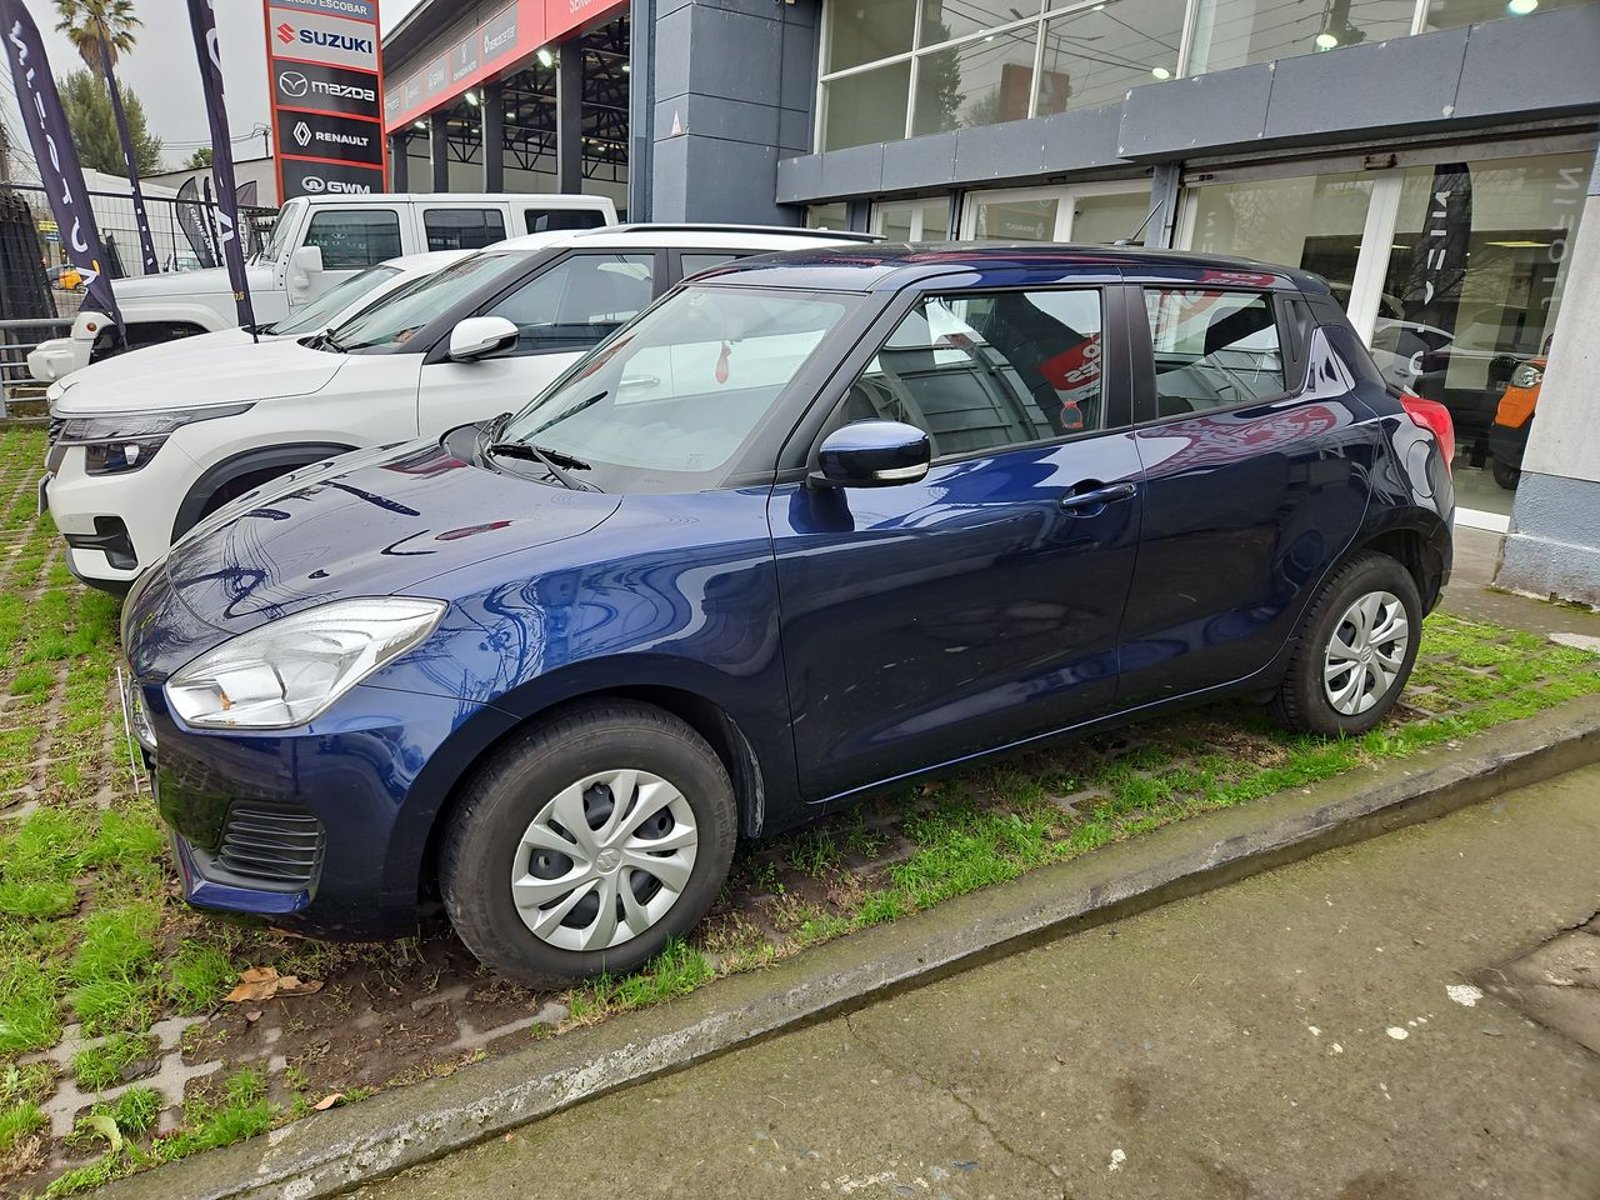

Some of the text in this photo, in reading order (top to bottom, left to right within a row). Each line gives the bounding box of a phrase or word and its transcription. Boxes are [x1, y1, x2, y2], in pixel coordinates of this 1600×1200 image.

[320, 0, 367, 15] ESCOBAR
[299, 29, 373, 54] SUZUKI
[311, 80, 375, 102] mazda
[315, 131, 369, 147] RENAULT
[327, 180, 371, 194] GWM
